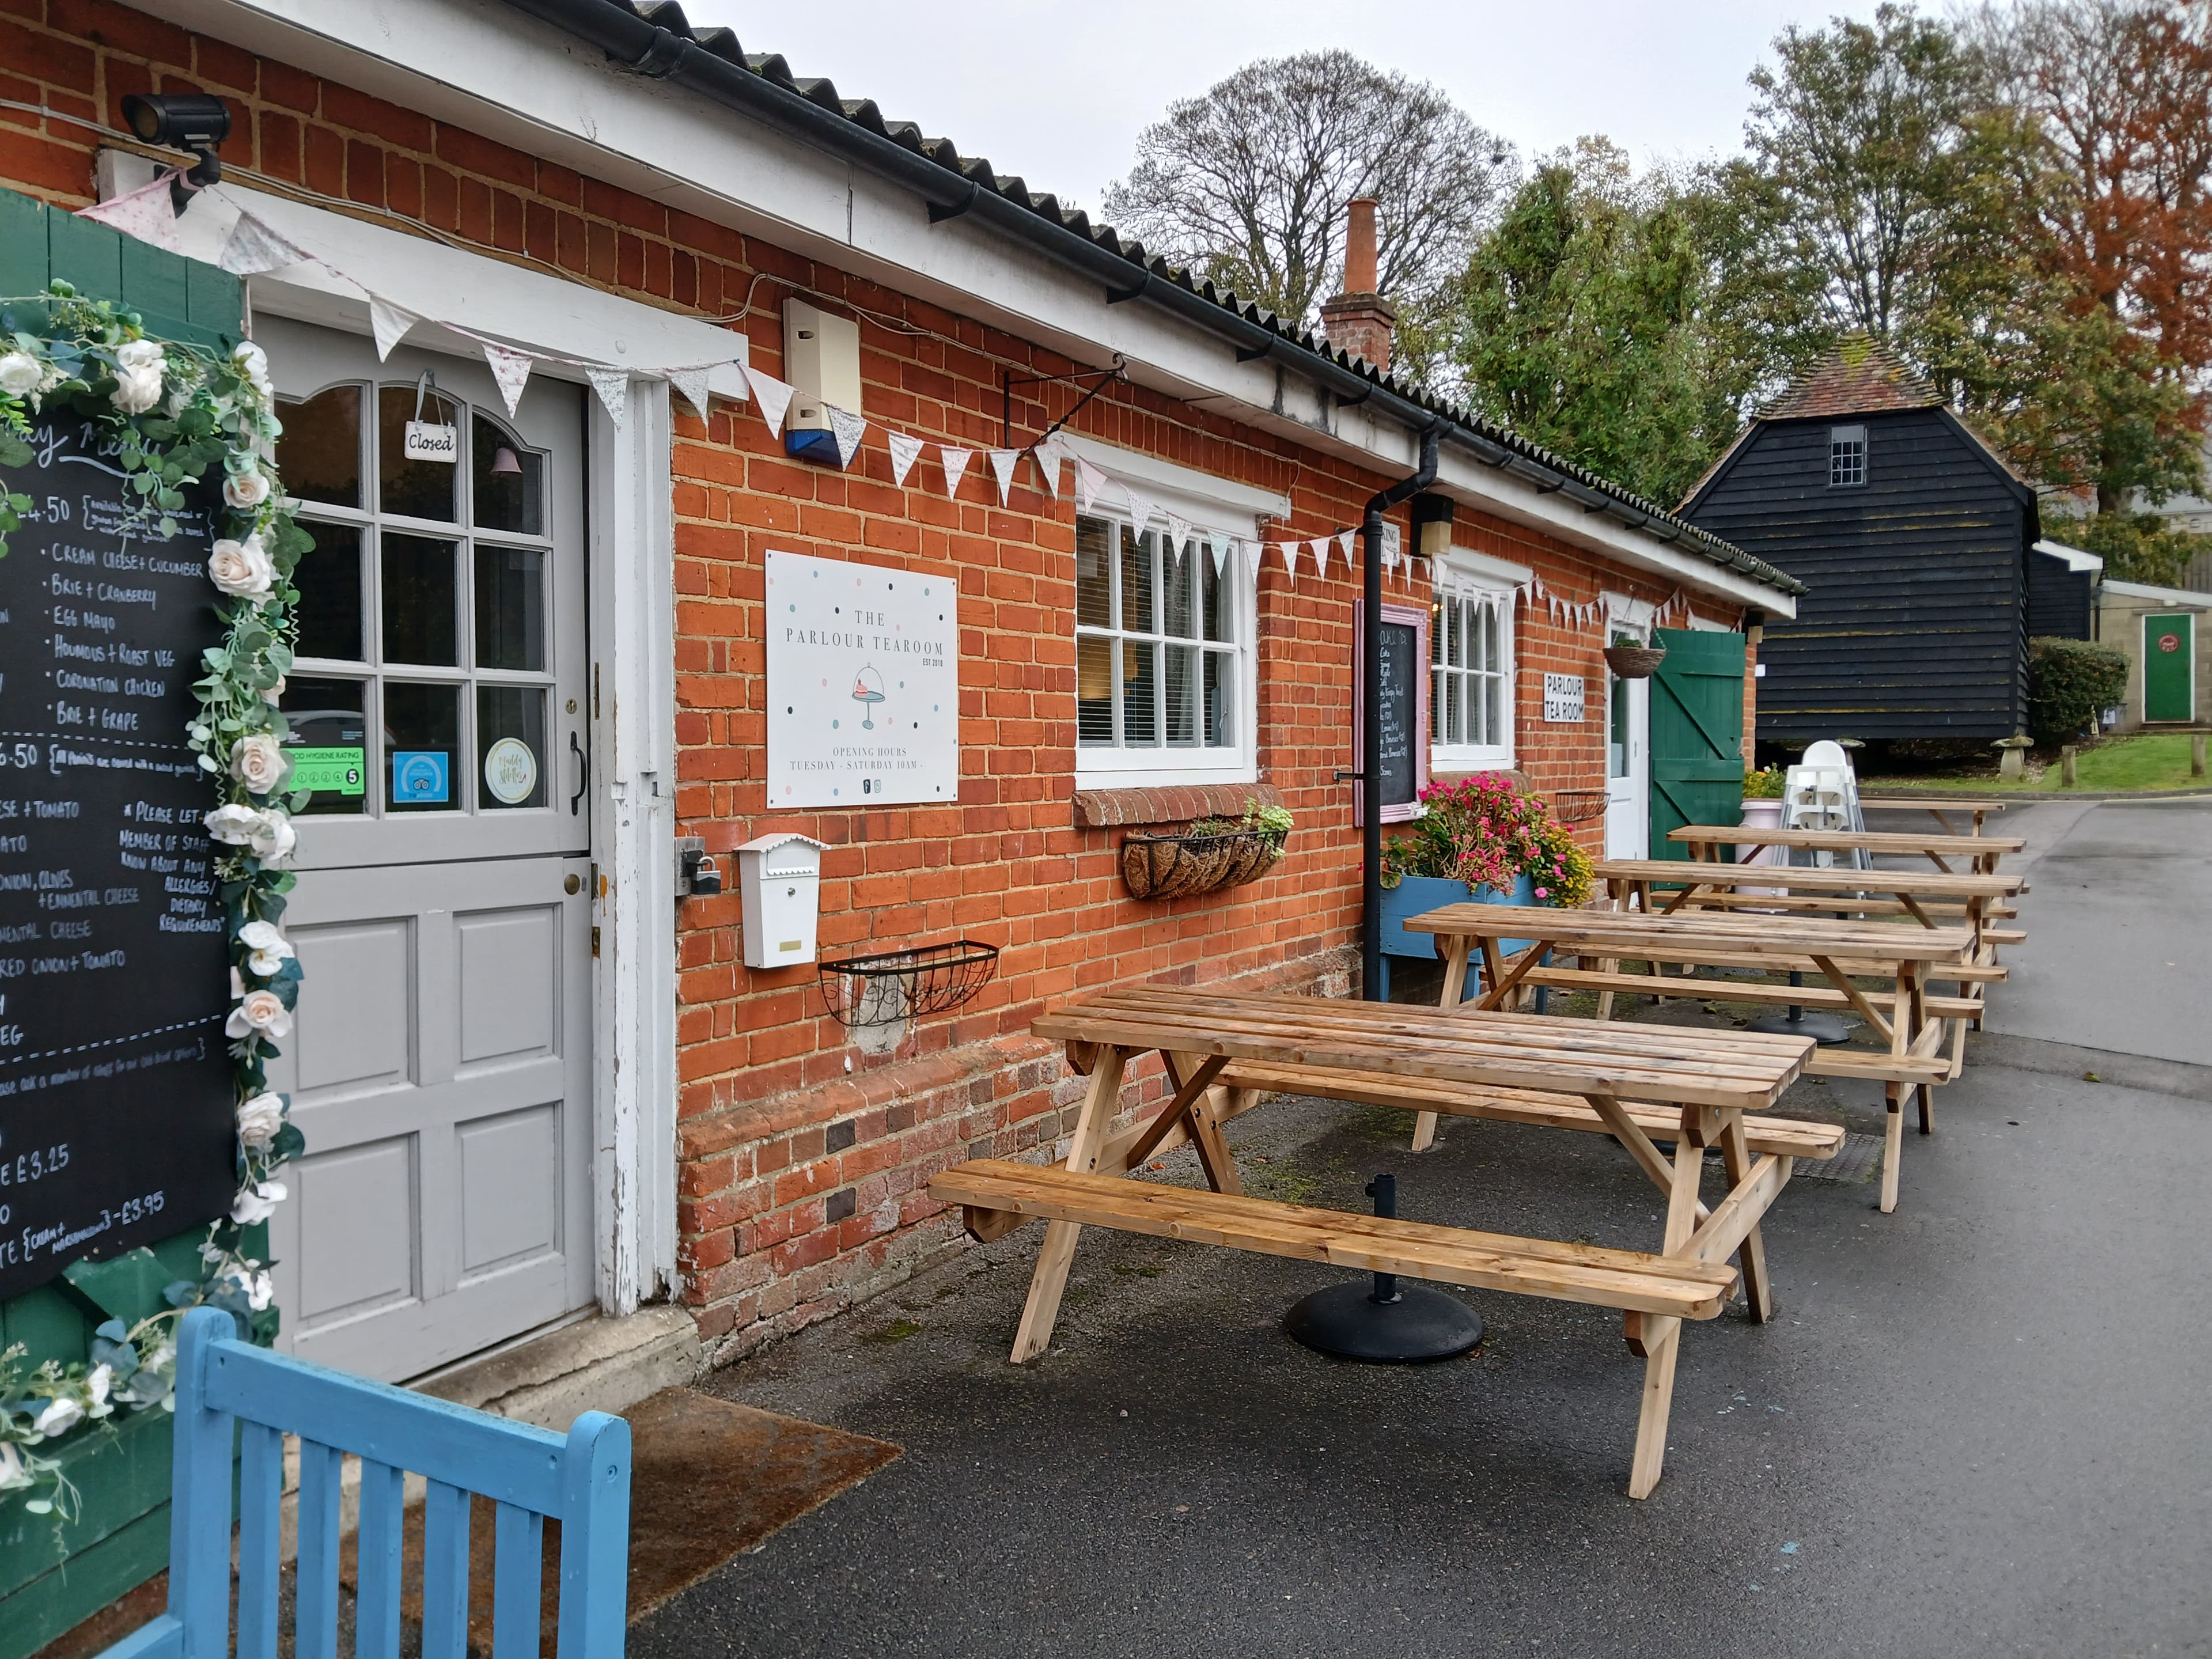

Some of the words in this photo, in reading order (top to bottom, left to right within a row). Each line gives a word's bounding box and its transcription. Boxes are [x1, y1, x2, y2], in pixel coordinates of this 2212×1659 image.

[409, 433, 454, 452] Closed
[52, 543, 96, 566] CREAM
[148, 556, 203, 578] CUCUMBER
[51, 573, 83, 596] BRIE
[97, 582, 156, 611] CRANBERRY
[54, 605, 78, 627] EGG
[855, 610, 885, 626] THE
[55, 634, 105, 662] HOUMOUS
[119, 643, 149, 666] ROAST
[154, 649, 175, 667] VEG
[786, 628, 864, 649] PARLOUR
[873, 637, 943, 656] TEAROOM
[923, 658, 931, 666] EST
[56, 669, 119, 692] CORONATION
[124, 677, 165, 698] CHICKEN
[1548, 676, 1582, 696] PARLOUR
[101, 708, 139, 732] GRAPE
[1546, 701, 1560, 719] TEA
[1562, 702, 1584, 721] ROOM
[833, 747, 874, 756] OPENING
[877, 748, 907, 757] HOURS
[790, 761, 835, 770] TUESDAY
[847, 760, 893, 770] SATURDAY
[897, 760, 916, 770] 10AM
[349, 770, 357, 783] 5
[33, 800, 79, 819] TOMATO
[135, 801, 173, 824] PLEASE
[179, 809, 200, 824] LET
[119, 830, 162, 851] MEMBER
[81, 949, 126, 969] TOMATO
